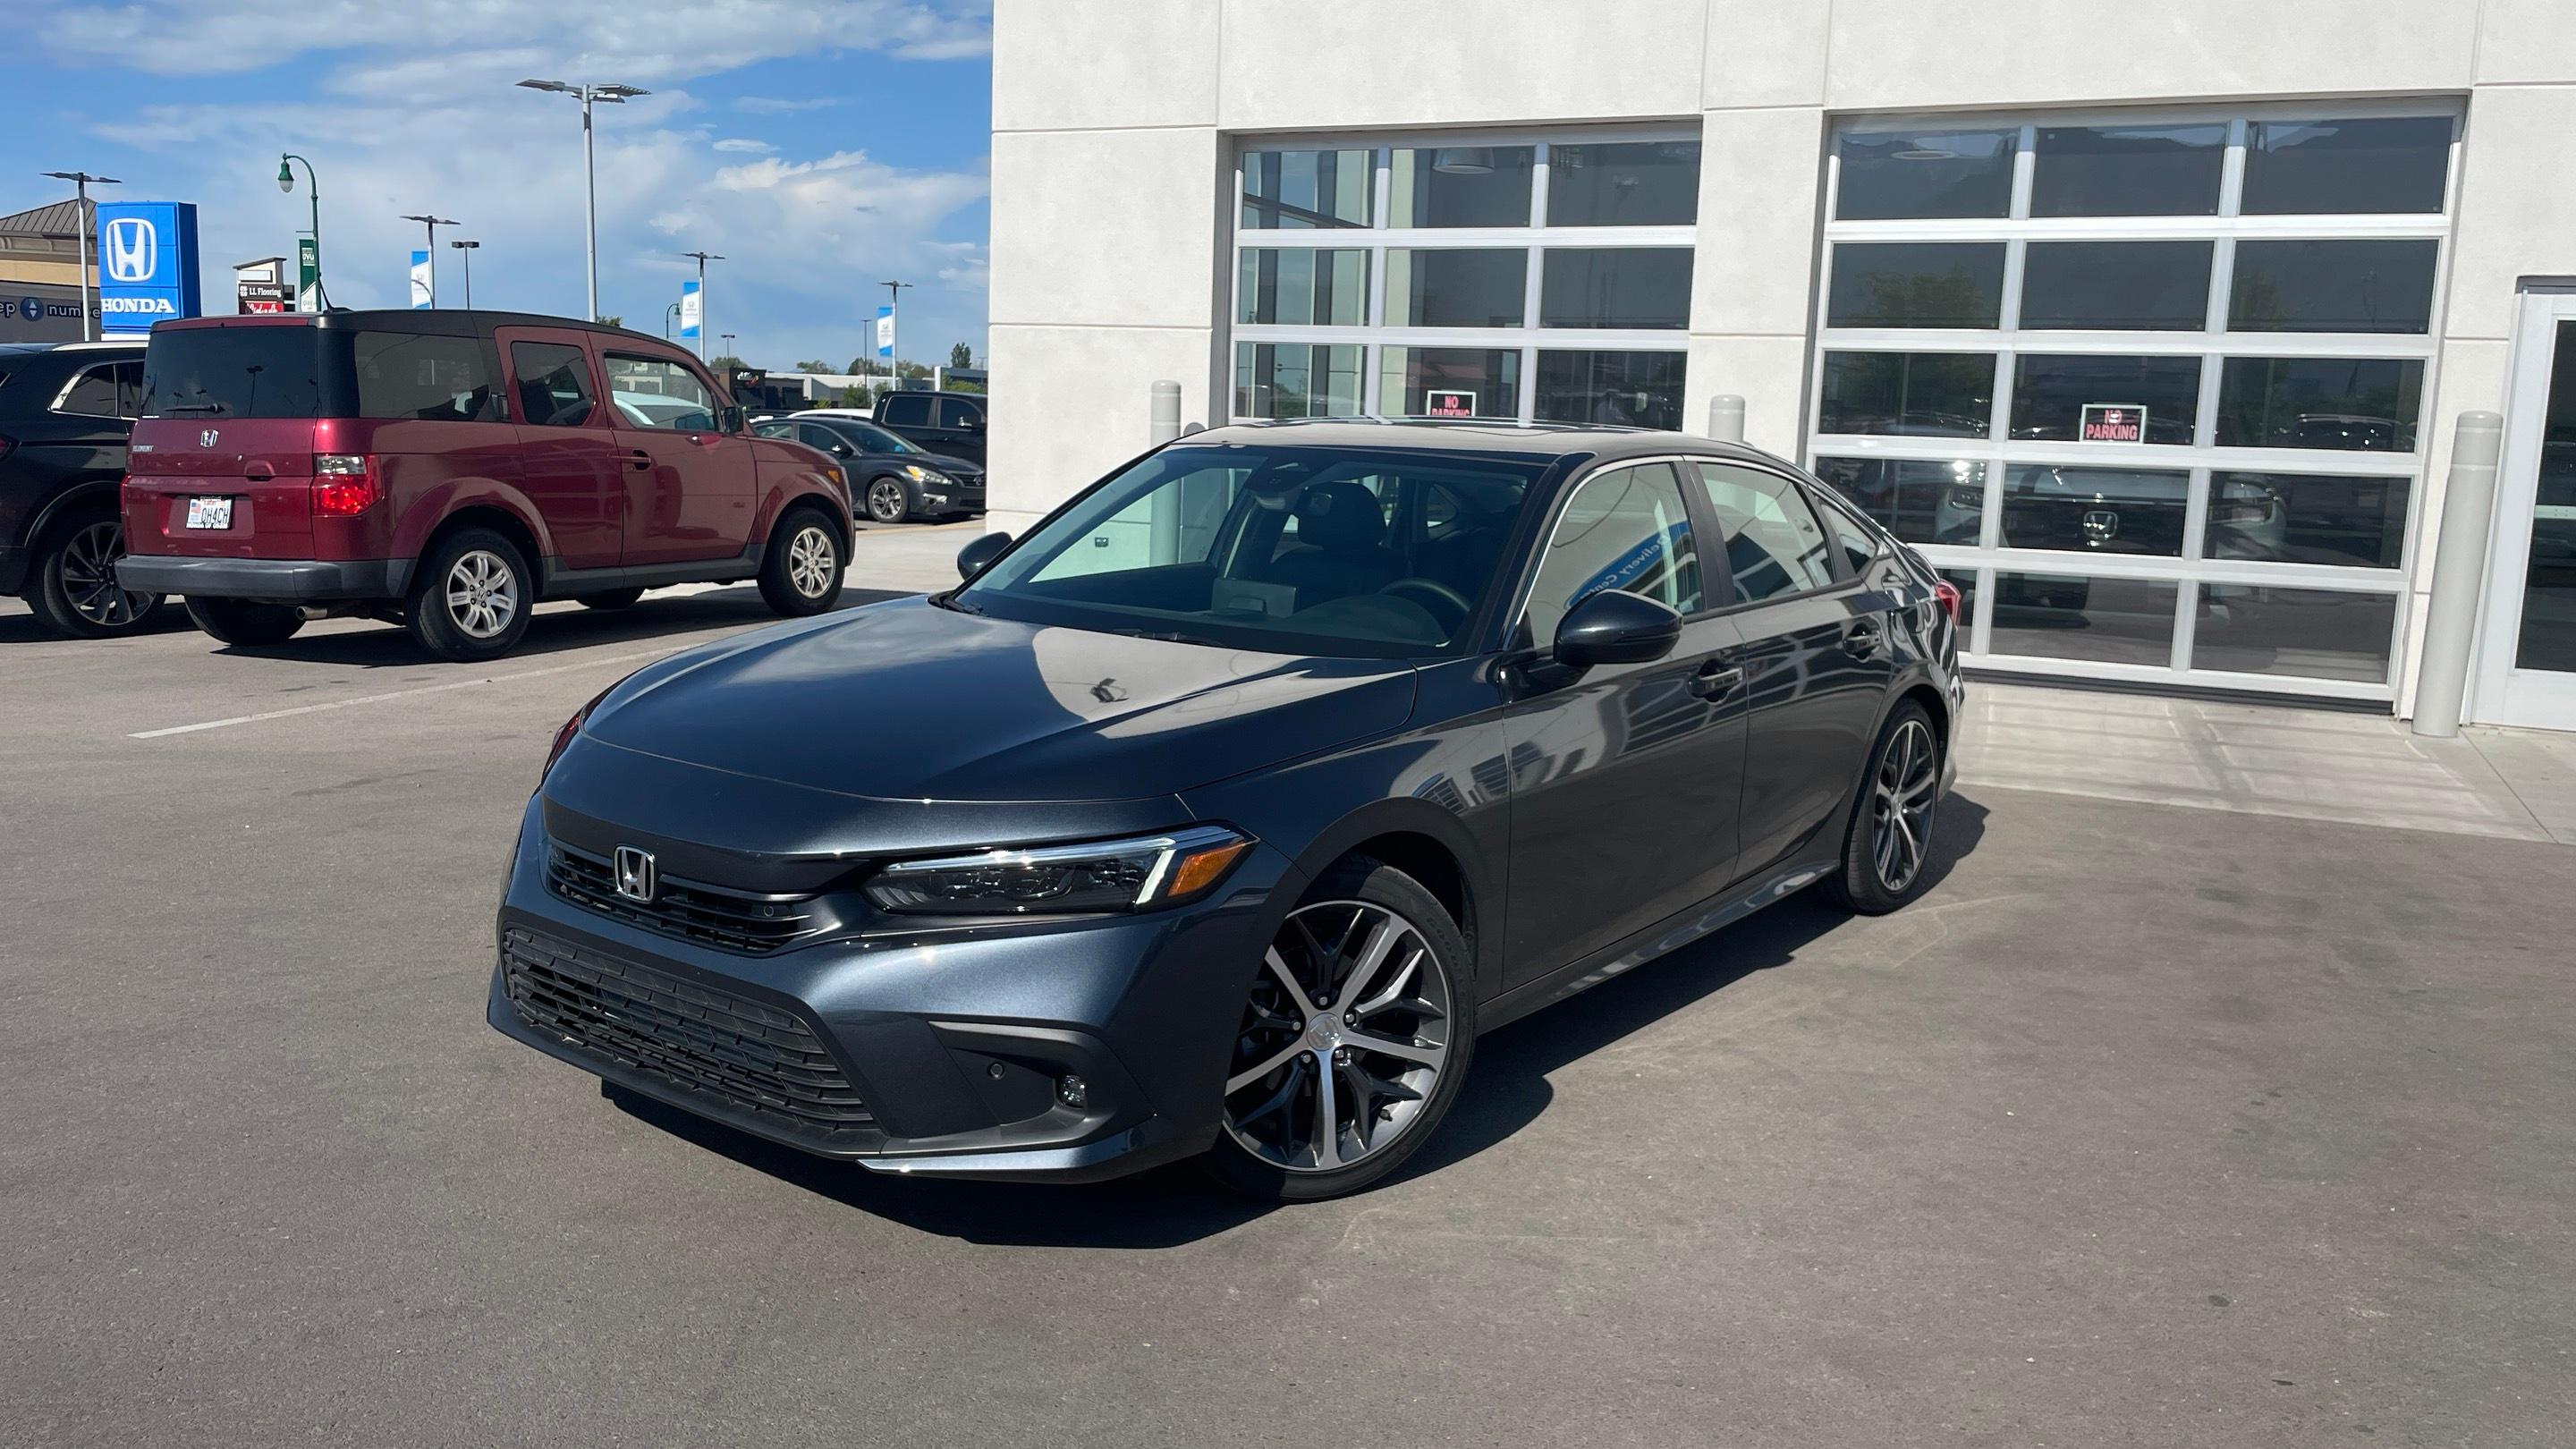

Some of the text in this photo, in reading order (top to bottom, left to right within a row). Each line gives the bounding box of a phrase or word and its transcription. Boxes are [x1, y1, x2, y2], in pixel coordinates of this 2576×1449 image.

[249, 287, 282, 298] LL Flooring
[48, 305, 100, 318] nume
[100, 298, 175, 313] HONDA
[1445, 395, 1459, 409] NO
[2104, 409, 2123, 424] NO
[2085, 423, 2138, 440] PARKING
